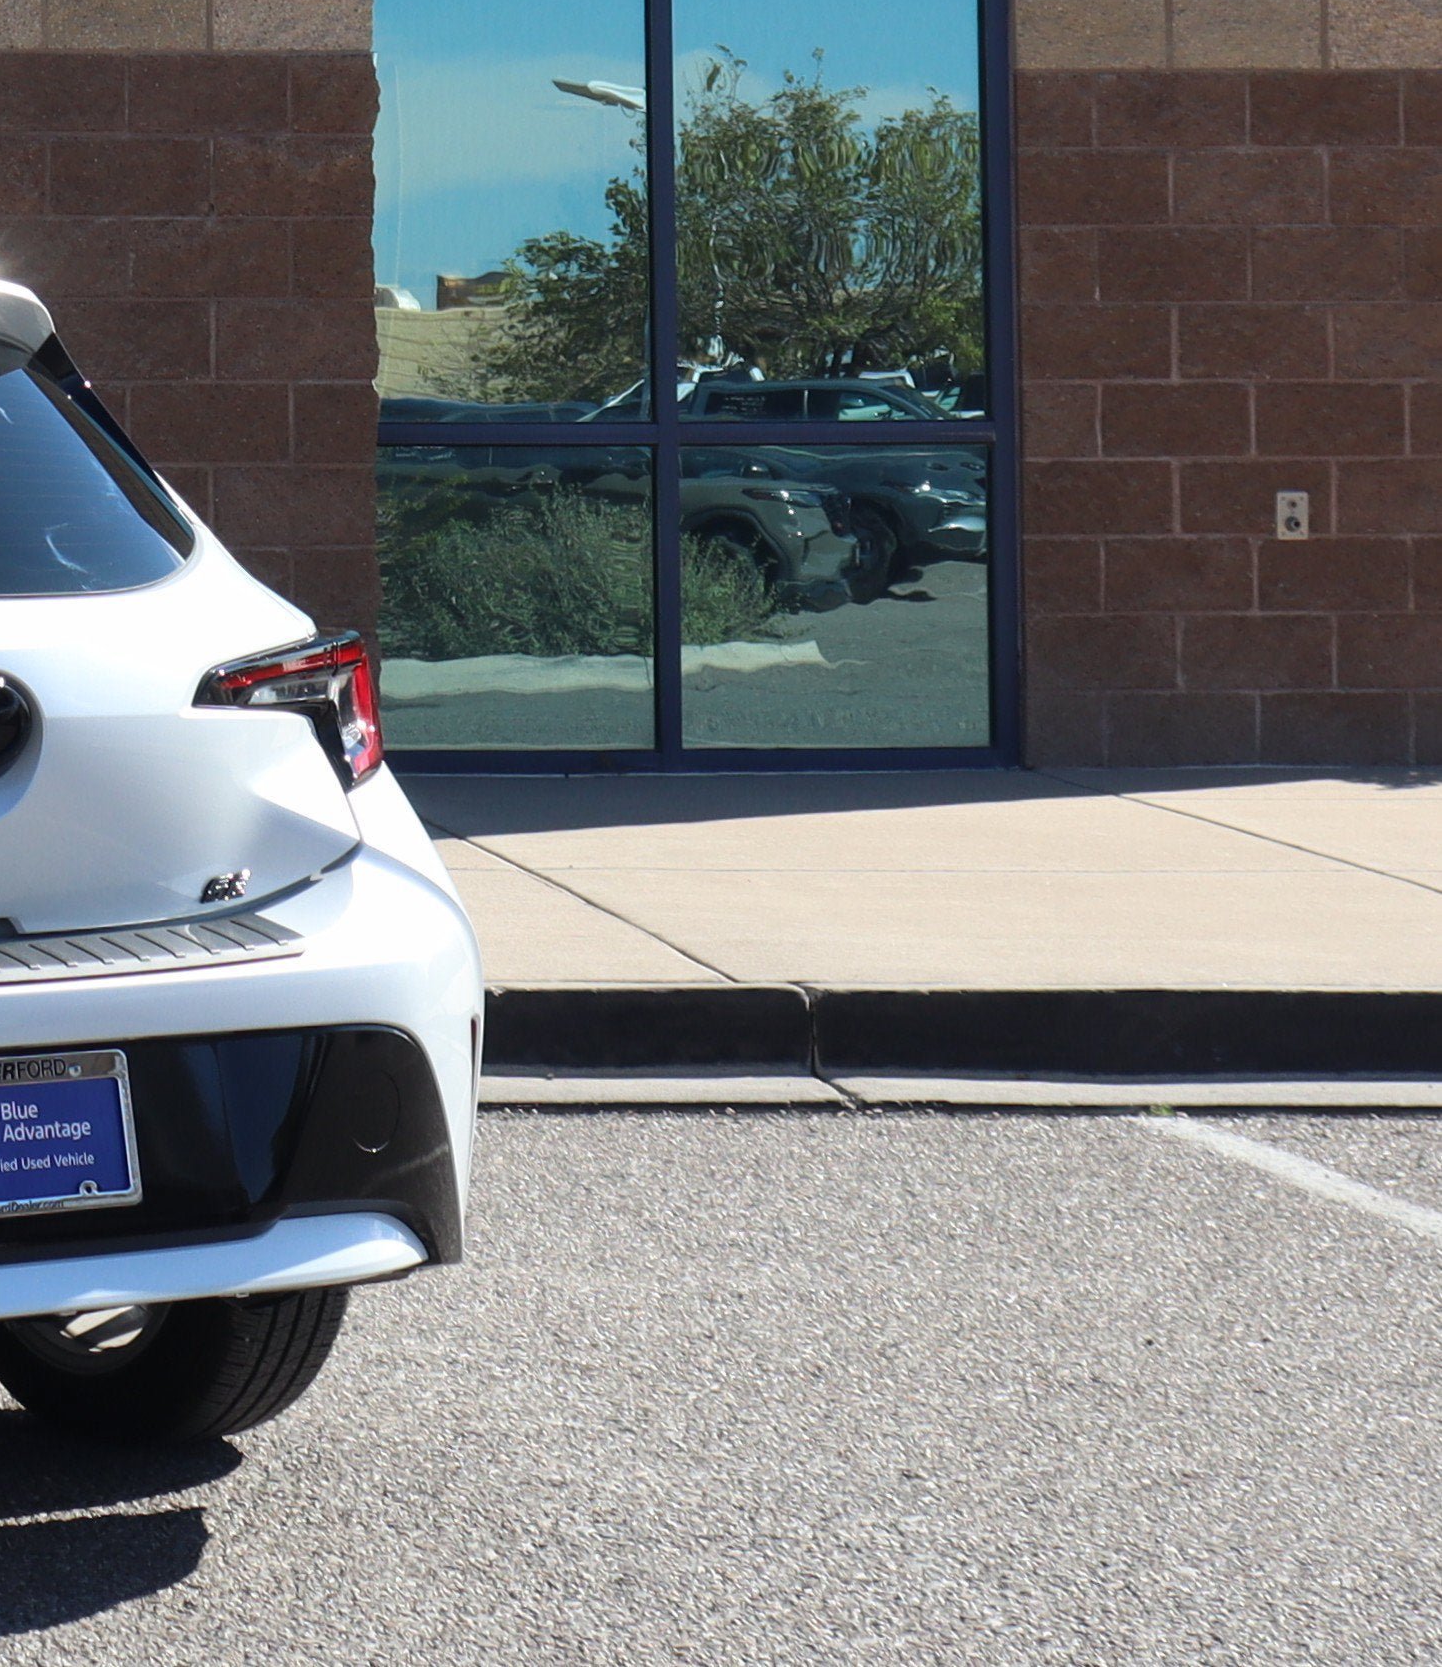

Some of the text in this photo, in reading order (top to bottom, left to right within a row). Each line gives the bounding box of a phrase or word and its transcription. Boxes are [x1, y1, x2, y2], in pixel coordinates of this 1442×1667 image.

[0, 1101, 39, 1121] Blue
[3, 1119, 92, 1143] Advantage
[21, 1154, 51, 1170] Used
[53, 1151, 95, 1168] Vehicle
